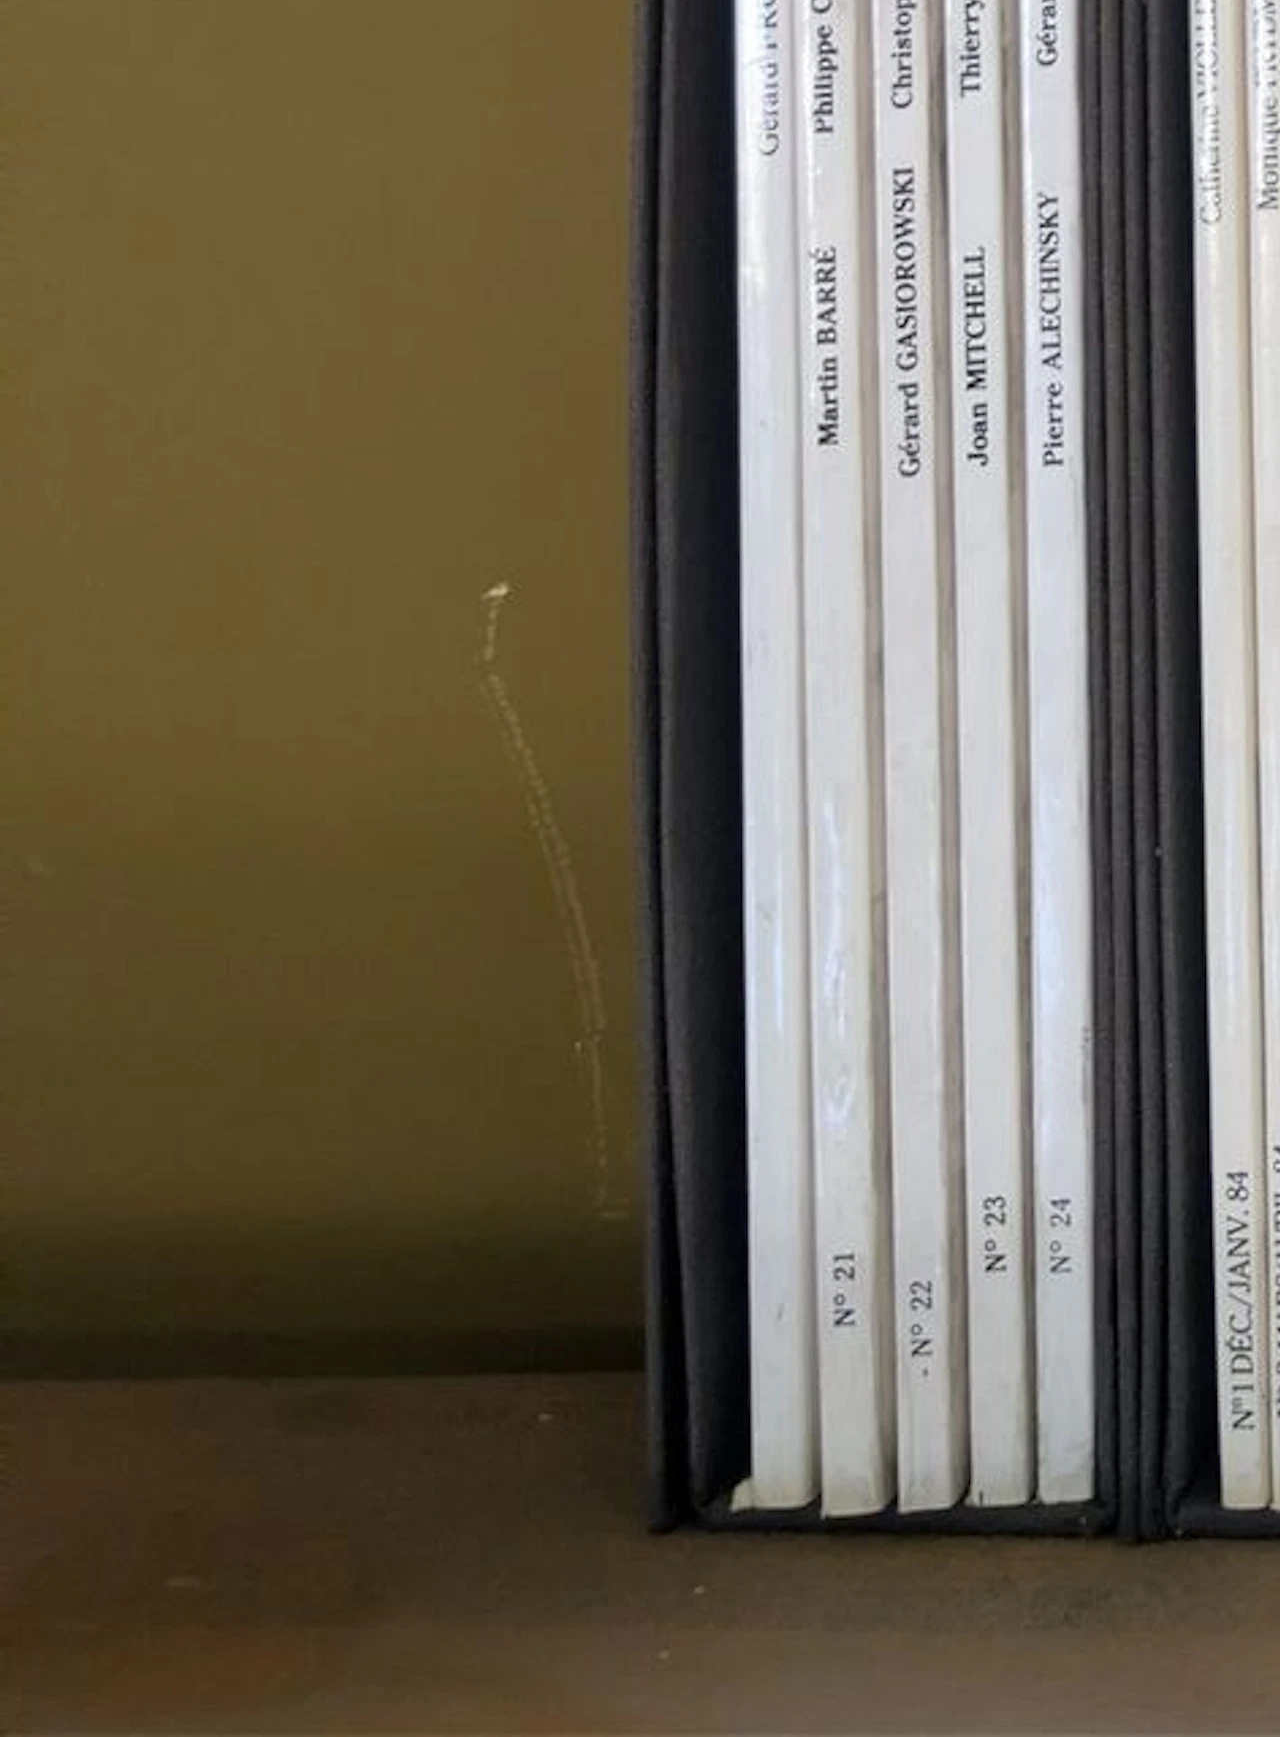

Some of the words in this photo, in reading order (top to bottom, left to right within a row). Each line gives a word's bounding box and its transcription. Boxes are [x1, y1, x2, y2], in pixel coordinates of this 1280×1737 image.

[812, 24, 838, 133] Philippe
[807, 245, 838, 346] BARRÉ
[892, 167, 918, 372] GASIOROWSKI
[1036, 192, 1062, 370] ALECHINSKY
[810, 355, 839, 447] Martin
[897, 381, 921, 478] Gérard
[1041, 382, 1064, 467] Pierre
